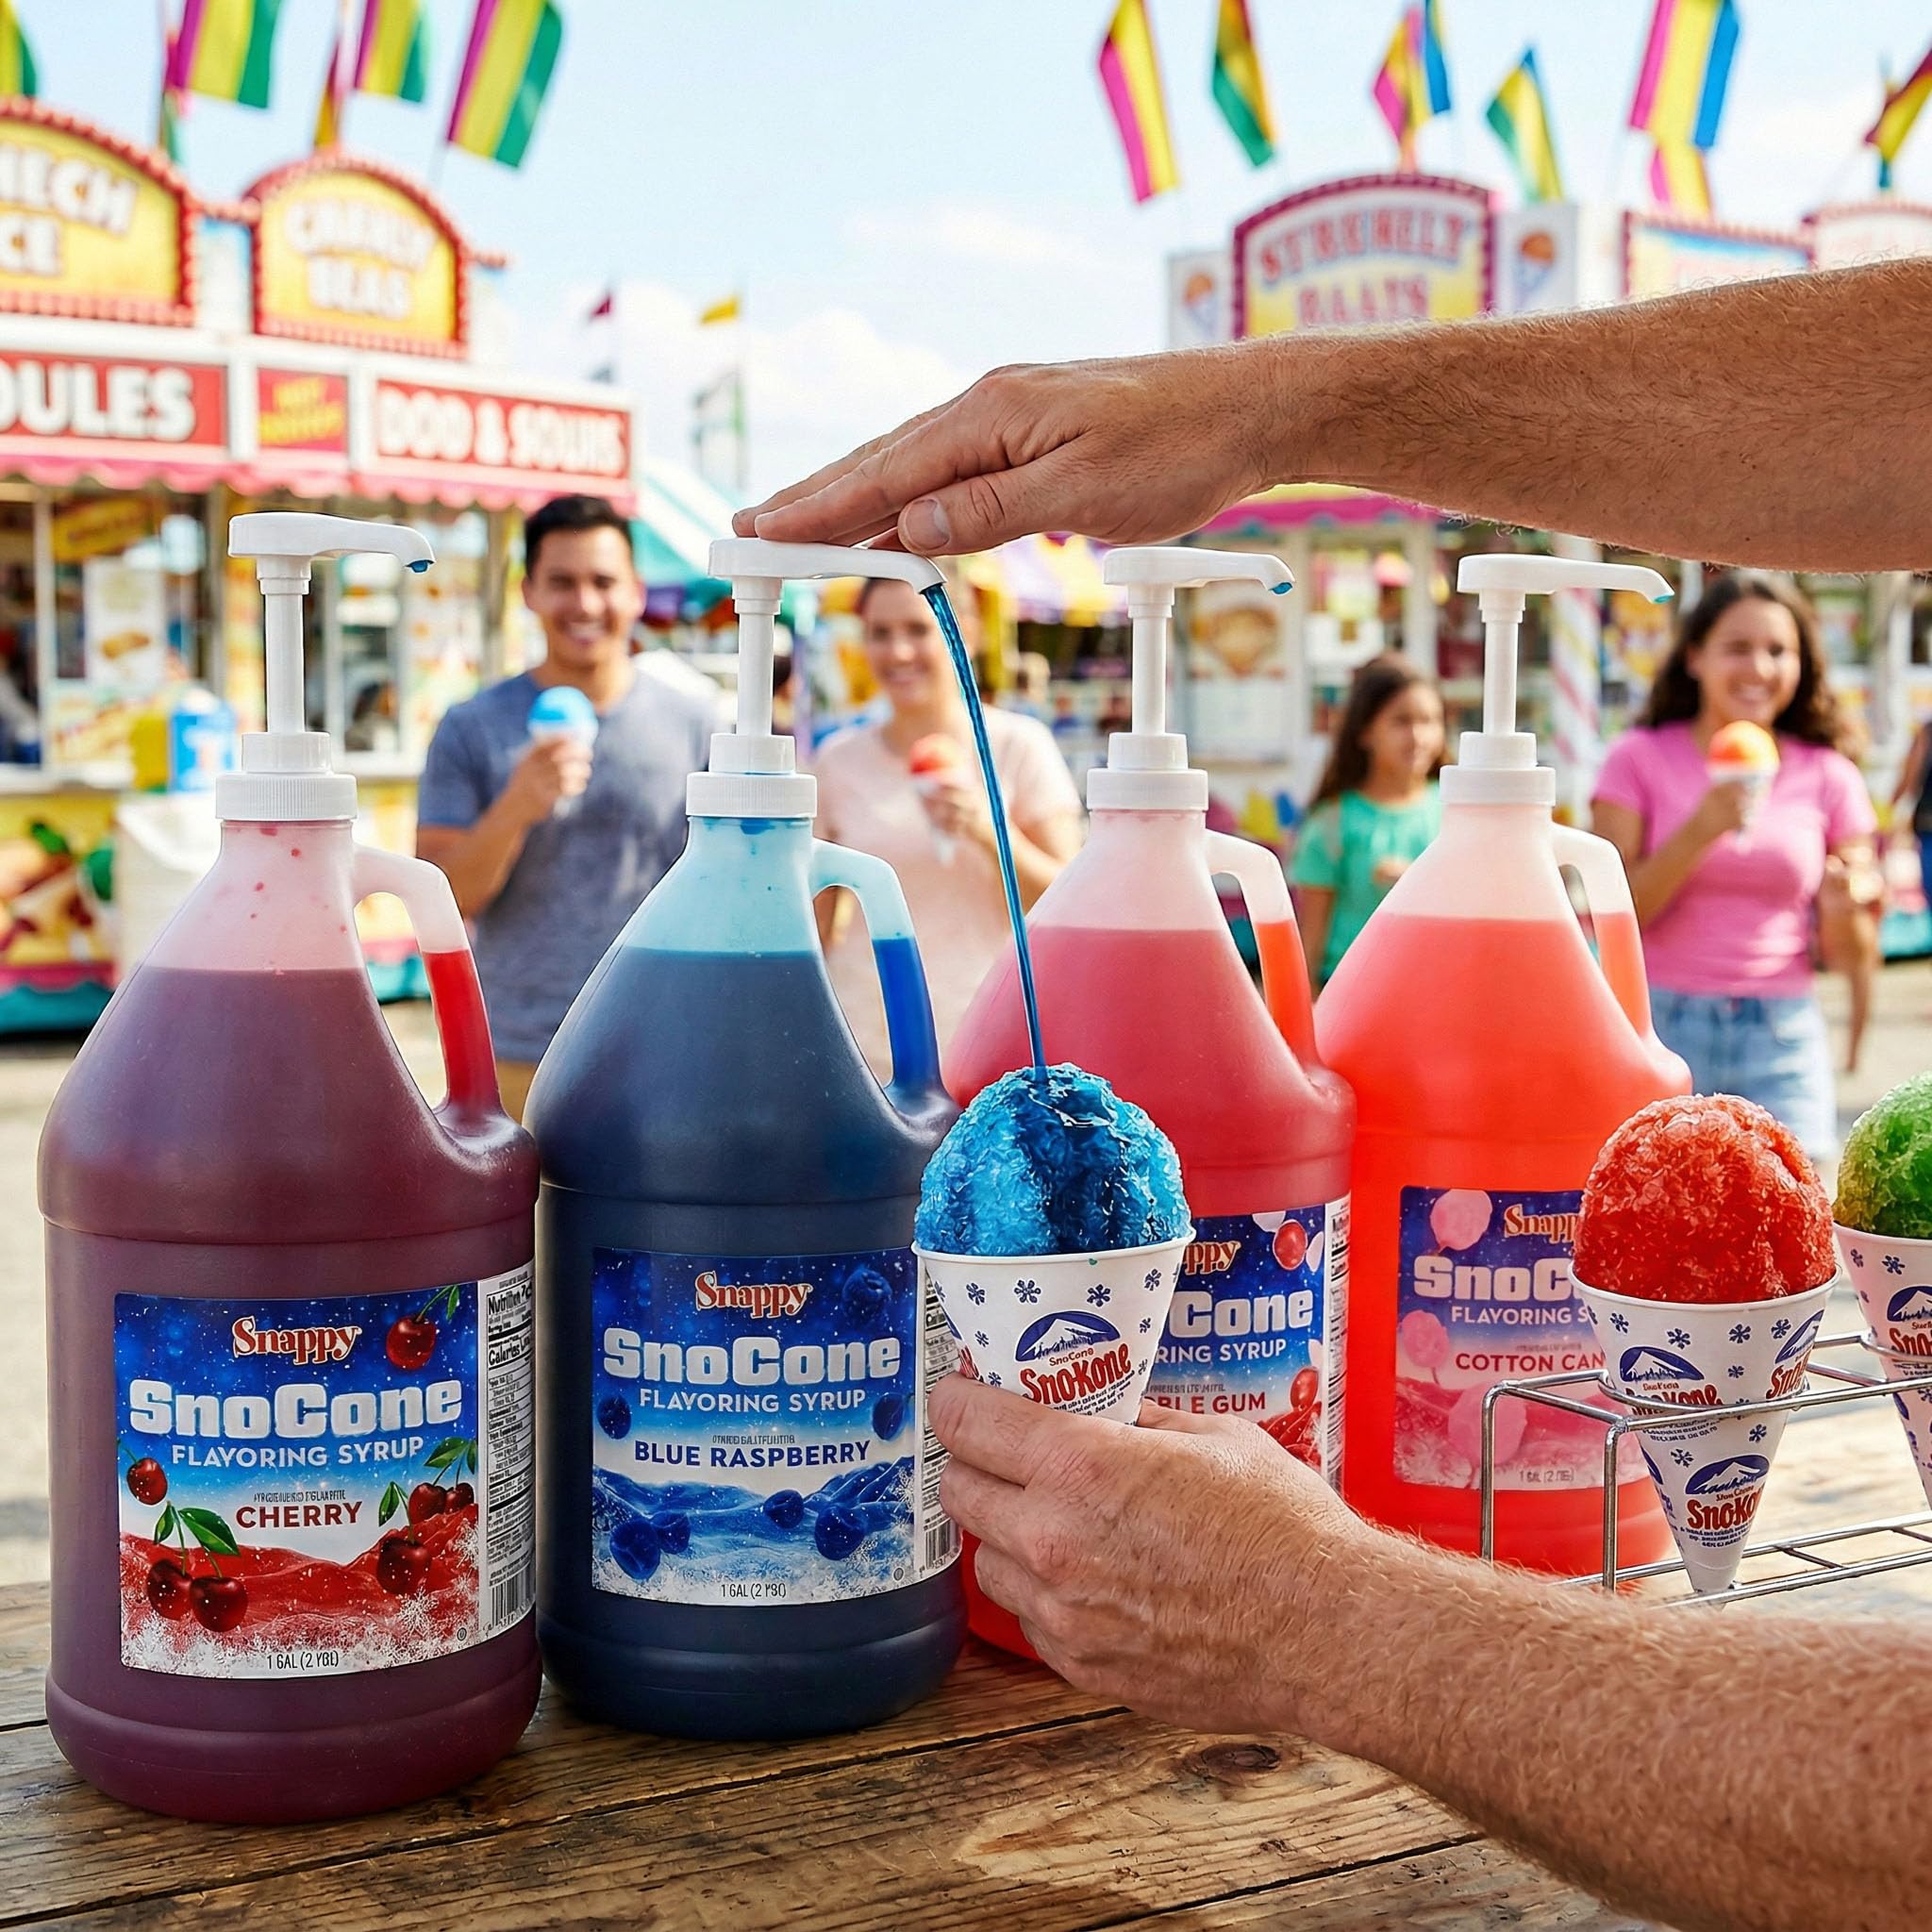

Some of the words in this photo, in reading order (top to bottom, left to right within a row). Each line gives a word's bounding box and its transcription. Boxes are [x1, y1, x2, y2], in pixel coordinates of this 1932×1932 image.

[1504, 1204, 1582, 1244] Snapp
[1183, 1241, 1241, 1275] ppy
[1414, 1256, 1583, 1301] SnoC
[695, 1271, 813, 1318] Snappy
[1170, 1289, 1314, 1339] Cone
[1452, 1307, 1572, 1325] FLAVORING
[232, 1315, 362, 1365] Snappy
[1157, 1346, 1211, 1363] RING
[1219, 1339, 1287, 1360] SYRUP
[604, 1327, 900, 1386] SnoCone
[1456, 1354, 1548, 1372] COTTON
[1561, 1355, 1605, 1371] CAN
[129, 1379, 461, 1439] SnoCone
[640, 1389, 778, 1413] FLAVORING
[789, 1390, 866, 1412] SYRUP
[1212, 1392, 1266, 1413] GUM
[172, 1444, 327, 1468] FLAVORING
[339, 1437, 424, 1464] SYRUP
[635, 1441, 700, 1466] BLUE
[709, 1440, 871, 1468] RASPBERRY
[236, 1501, 362, 1528] CHERRY
[722, 1584, 726, 1597] 1
[267, 1655, 272, 1669] 1
